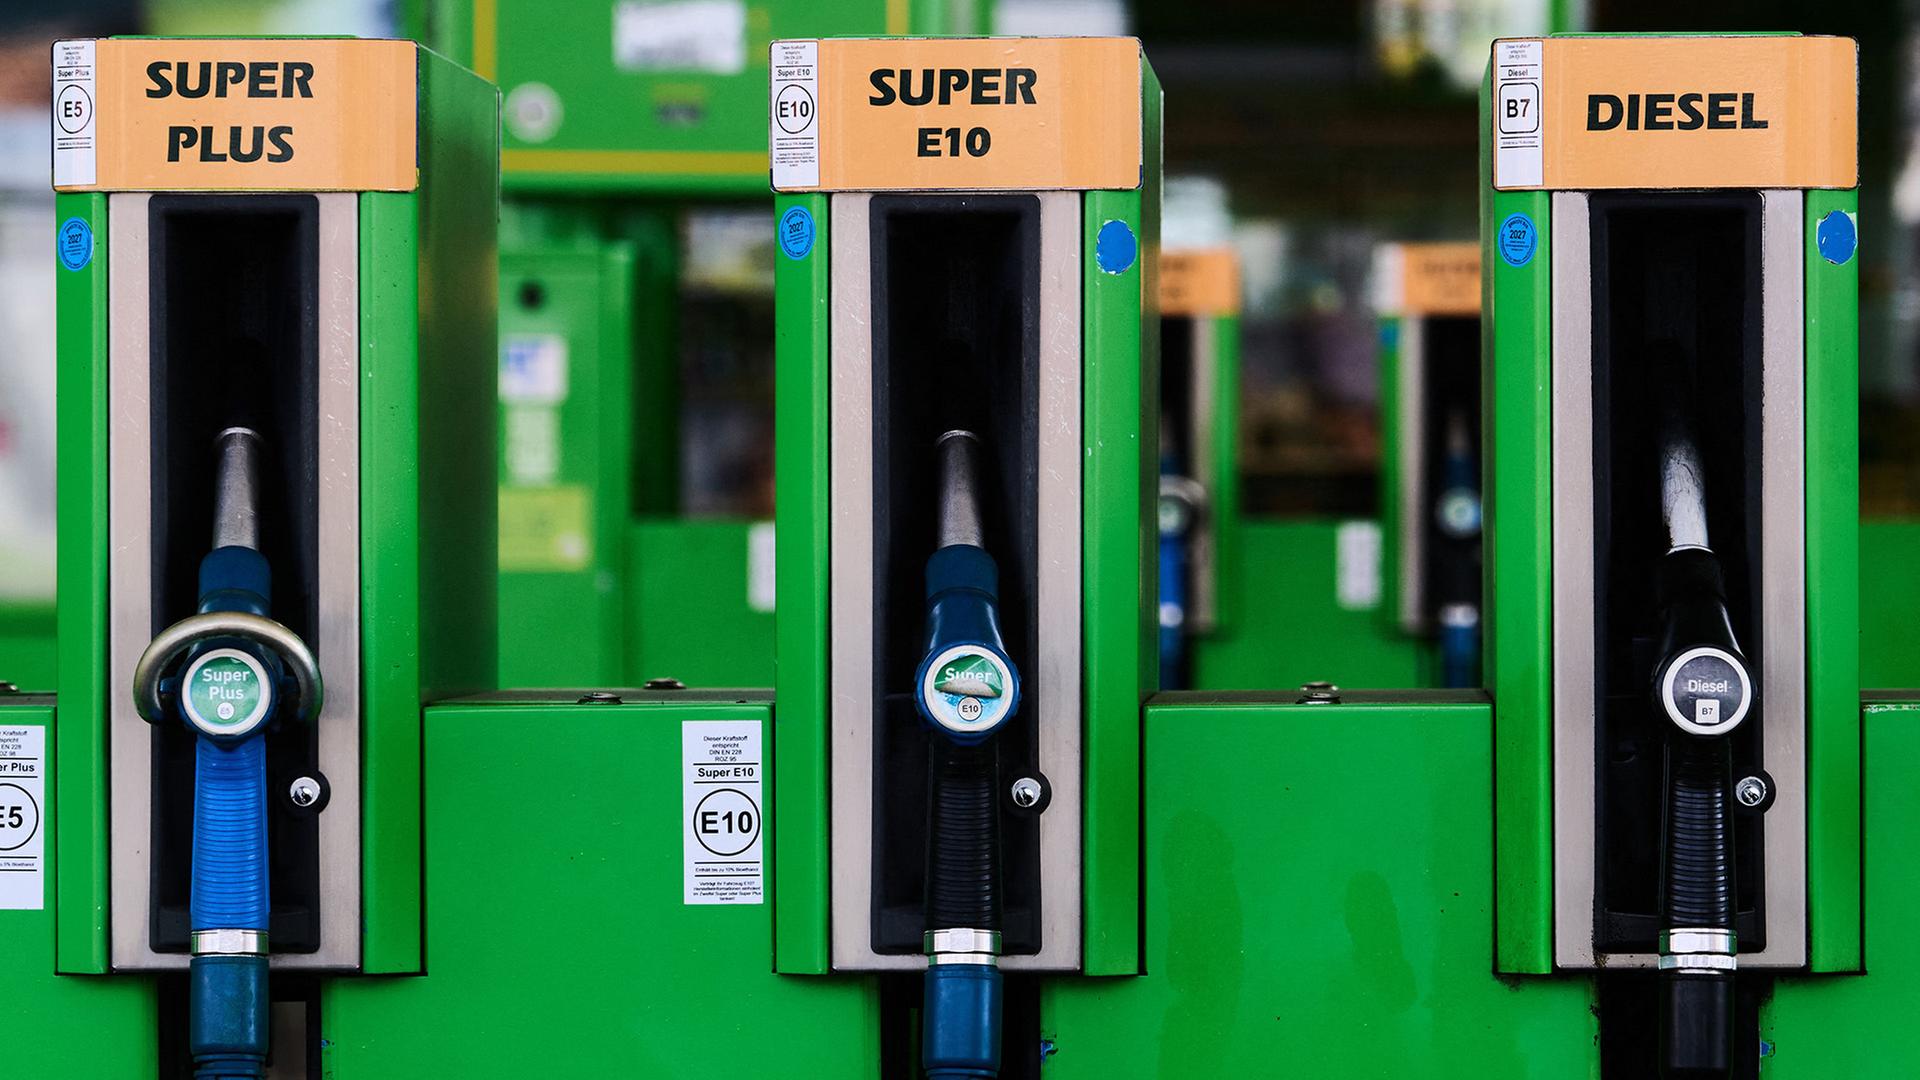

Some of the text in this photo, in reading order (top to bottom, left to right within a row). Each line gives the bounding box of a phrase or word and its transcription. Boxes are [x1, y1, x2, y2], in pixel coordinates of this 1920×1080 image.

[58, 69, 74, 77] Super
[778, 69, 796, 77] Super
[1508, 68, 1528, 76] Diesel
[146, 62, 314, 98] SUPER
[869, 69, 1037, 106] SUPER
[64, 101, 82, 118] E5
[779, 101, 810, 118] E10
[1506, 98, 1531, 118] B7
[1587, 93, 1769, 131] DIESEL
[168, 126, 294, 162] PLUS
[918, 127, 991, 157] E10
[789, 221, 804, 234] 2027
[68, 233, 82, 244] 2027
[1510, 230, 1526, 240] 2027
[202, 668, 250, 685] Super
[1688, 680, 1728, 692] Diesel
[208, 686, 244, 700] Plus
[962, 704, 979, 713] E10
[1702, 707, 1714, 716] B7
[12, 762, 34, 772] Plus
[698, 768, 754, 779] Super E10
[702, 811, 753, 834] E10
